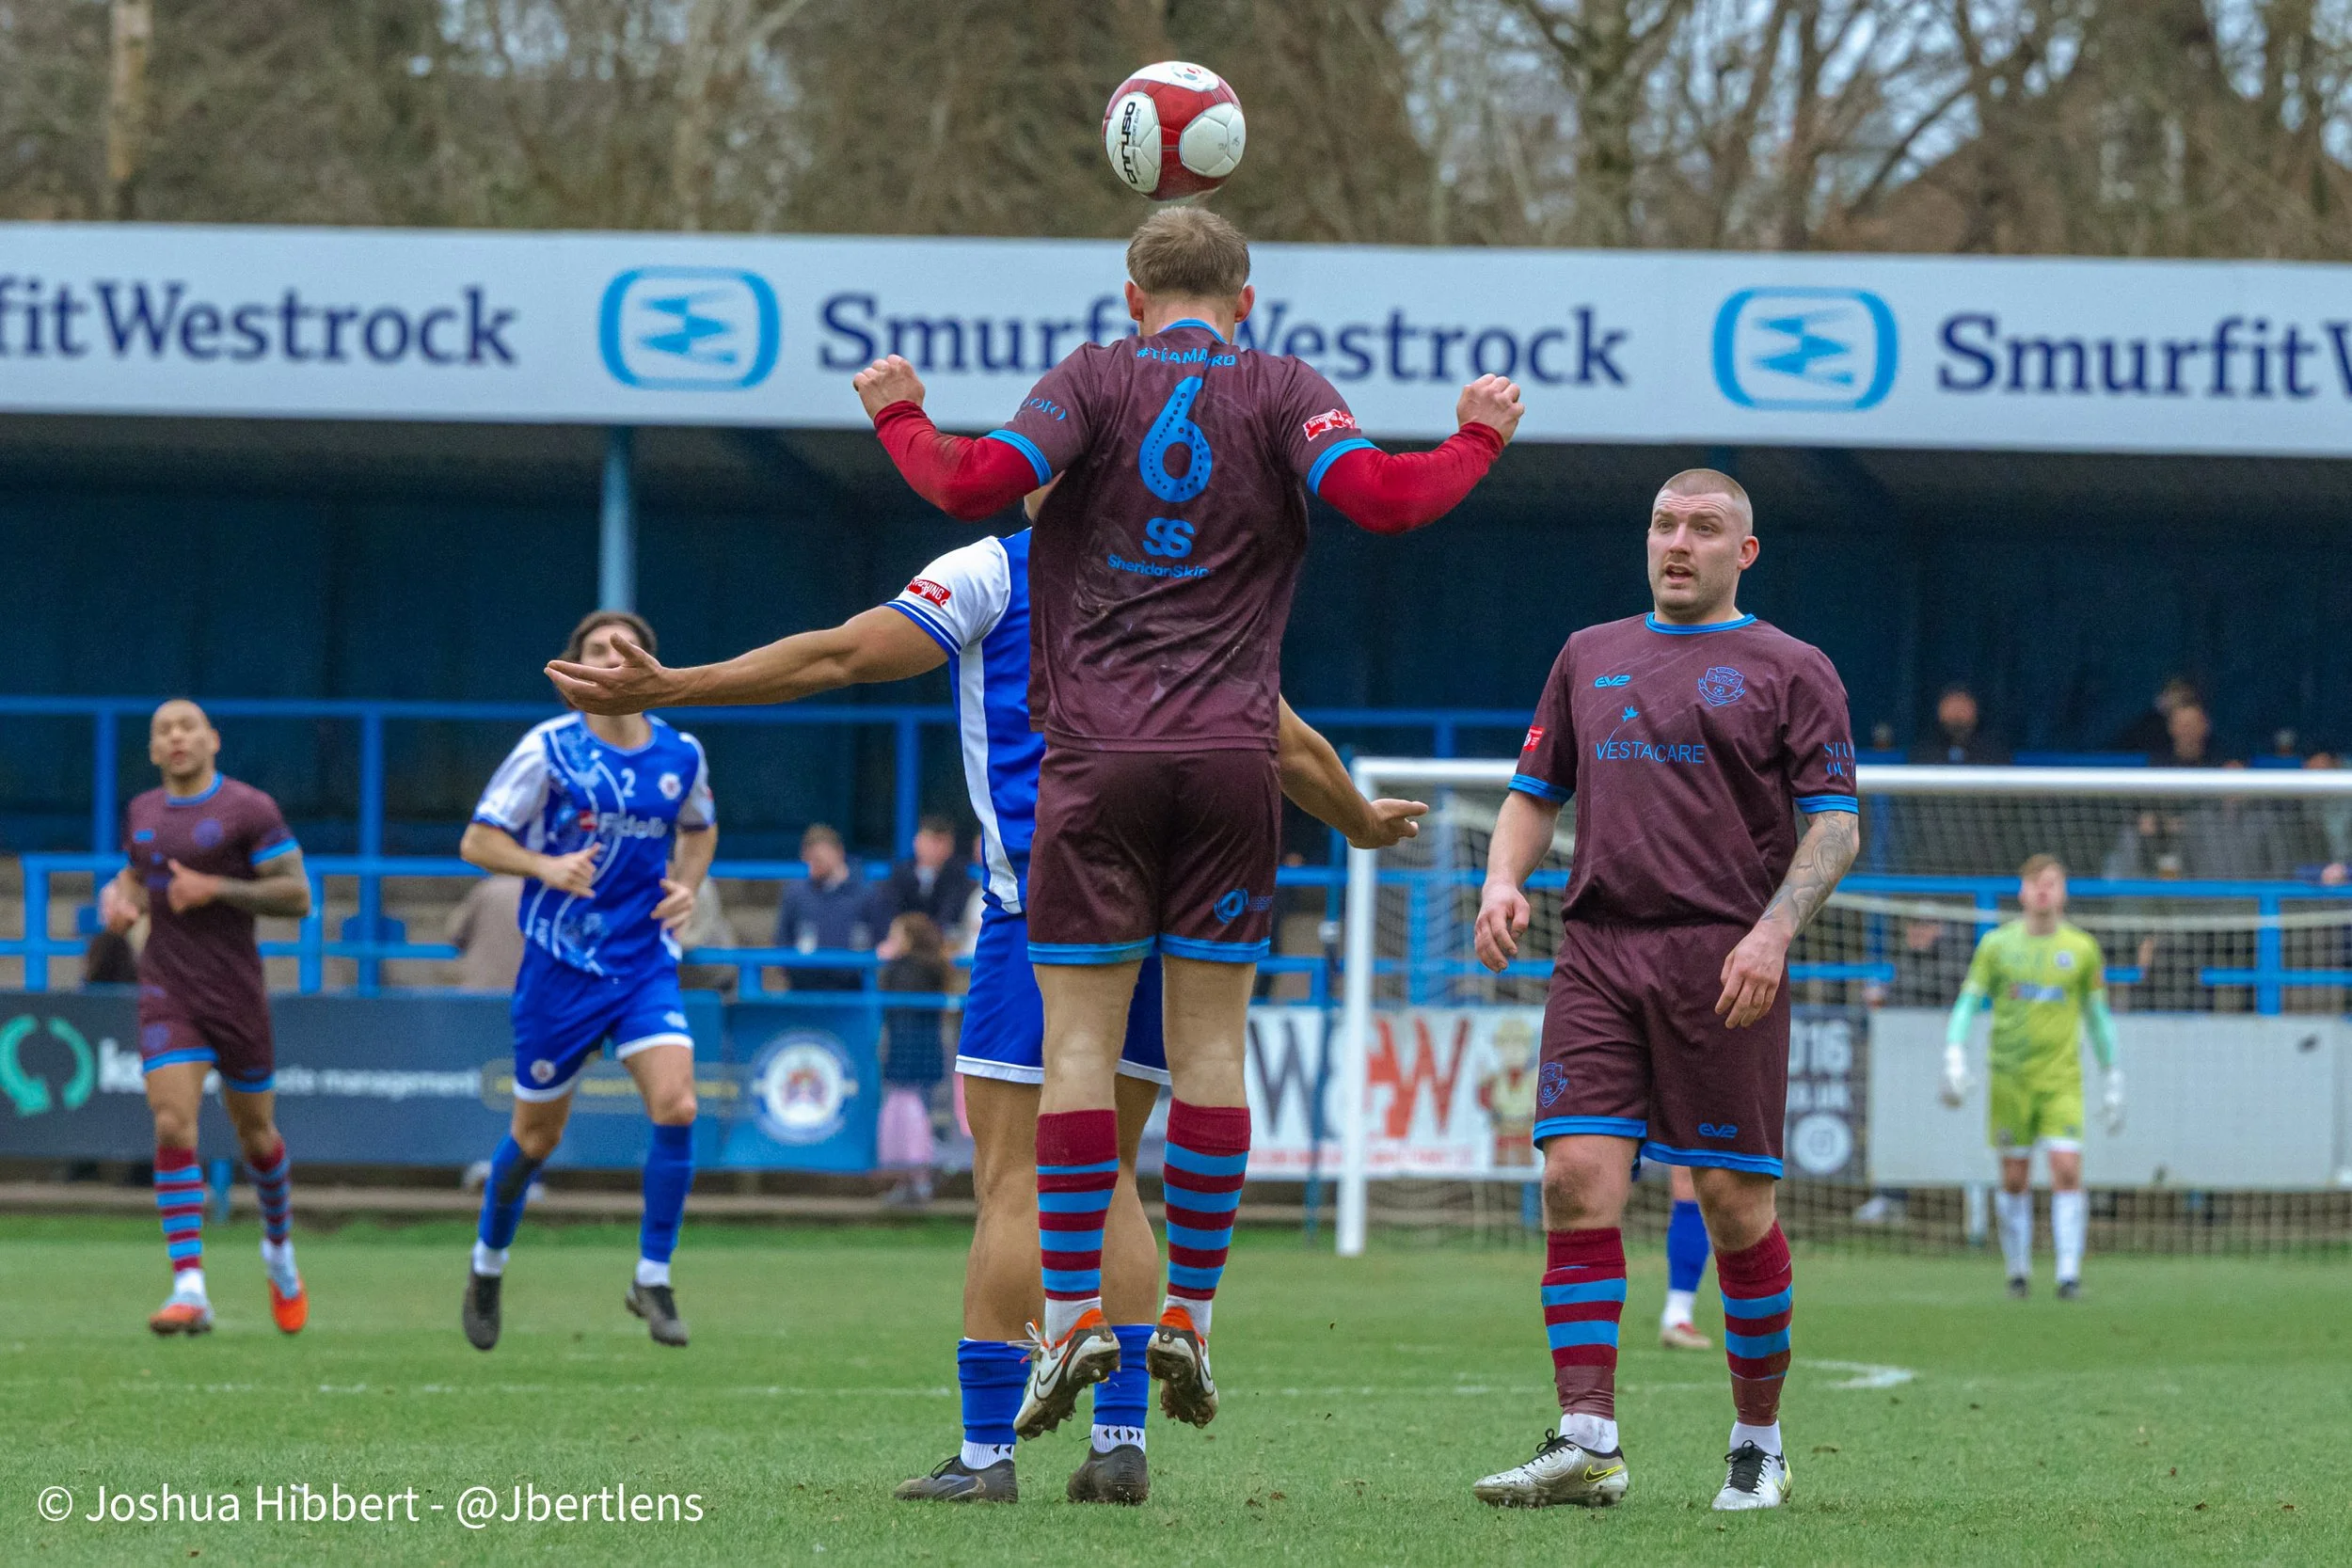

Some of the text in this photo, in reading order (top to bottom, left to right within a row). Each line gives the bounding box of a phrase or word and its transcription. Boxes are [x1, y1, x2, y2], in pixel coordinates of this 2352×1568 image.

[1138, 375, 1213, 503] 6
[1596, 729, 1706, 764] VESTACARE
[621, 768, 636, 799] 2
